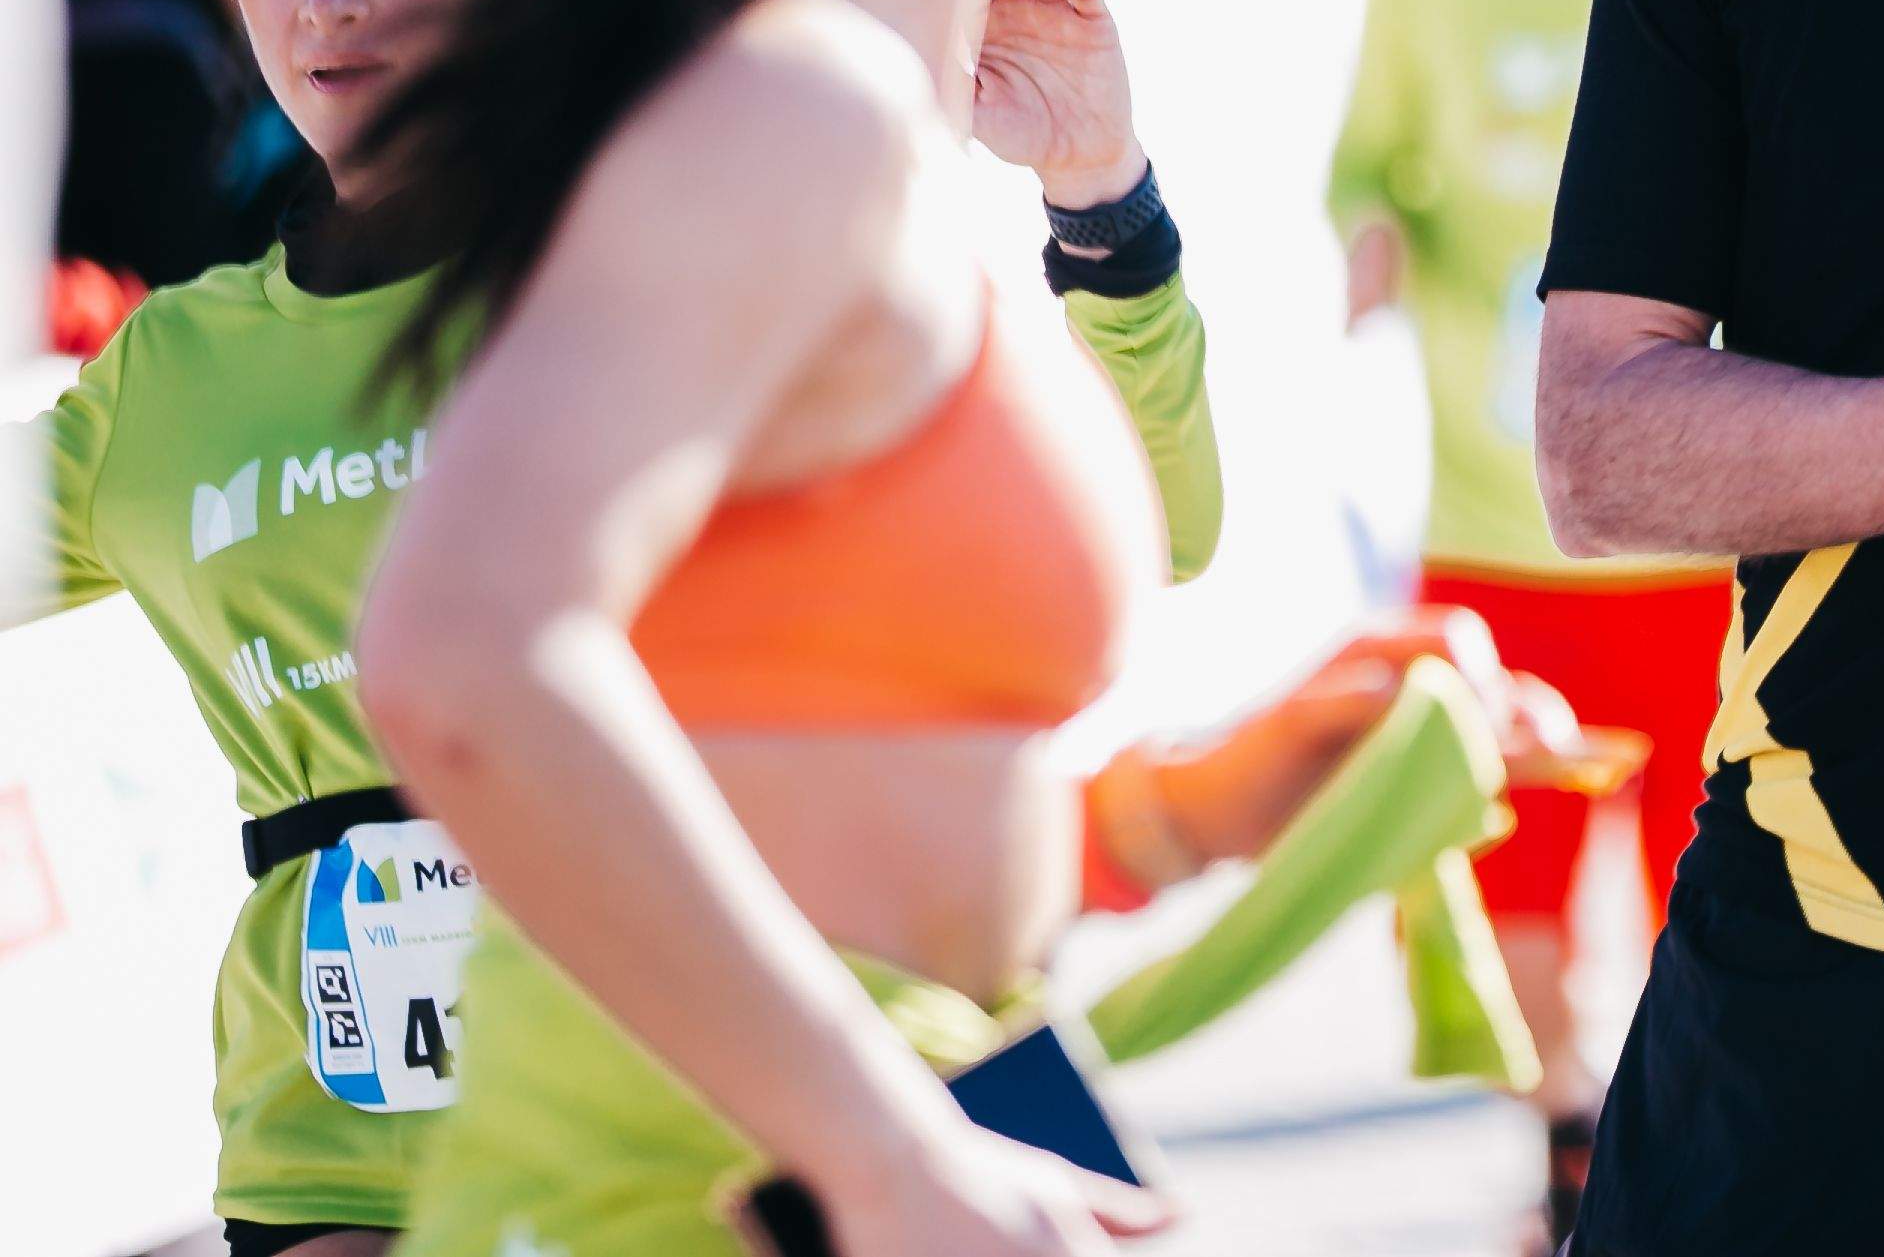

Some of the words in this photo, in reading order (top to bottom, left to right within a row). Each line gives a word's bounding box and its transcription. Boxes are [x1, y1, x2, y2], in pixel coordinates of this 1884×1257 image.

[286, 650, 359, 690] 15KM
[362, 925, 398, 947] VIII
[404, 997, 456, 1080] 4
